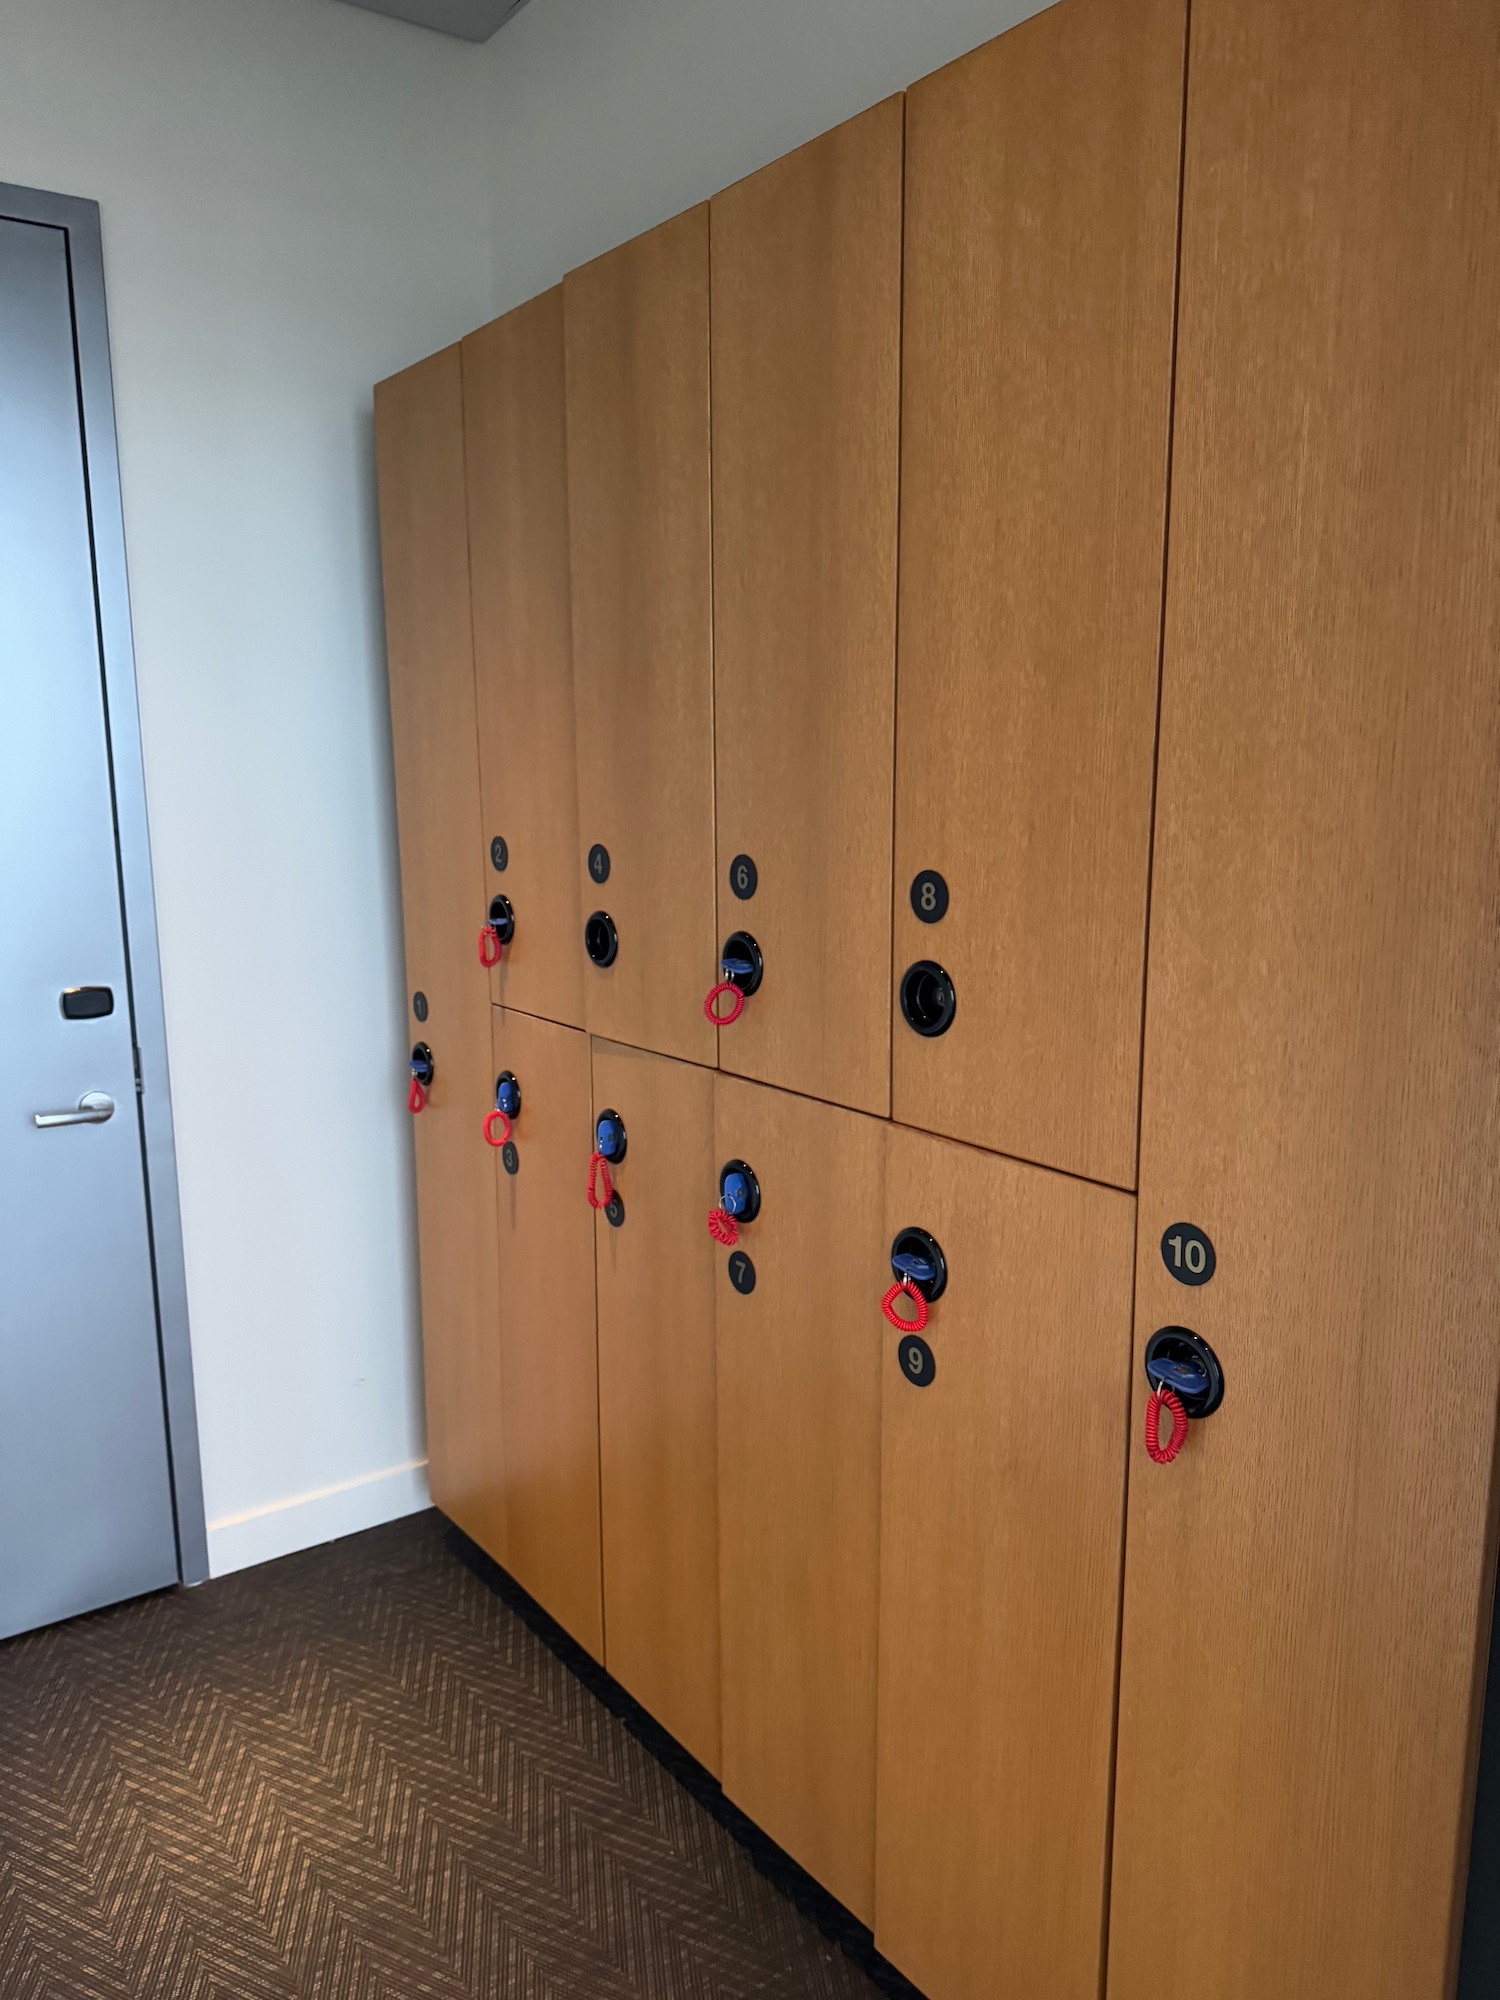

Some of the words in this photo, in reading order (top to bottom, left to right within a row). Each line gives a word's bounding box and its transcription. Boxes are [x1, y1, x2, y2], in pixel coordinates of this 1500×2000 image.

[495, 844, 502, 863] 2
[593, 853, 603, 874] 4
[737, 864, 749, 890] 6
[920, 881, 937, 911] 8
[506, 1148, 513, 1167] 3
[1168, 1235, 1206, 1274] 10
[735, 1260, 746, 1284] 7
[908, 1346, 924, 1375] 9
